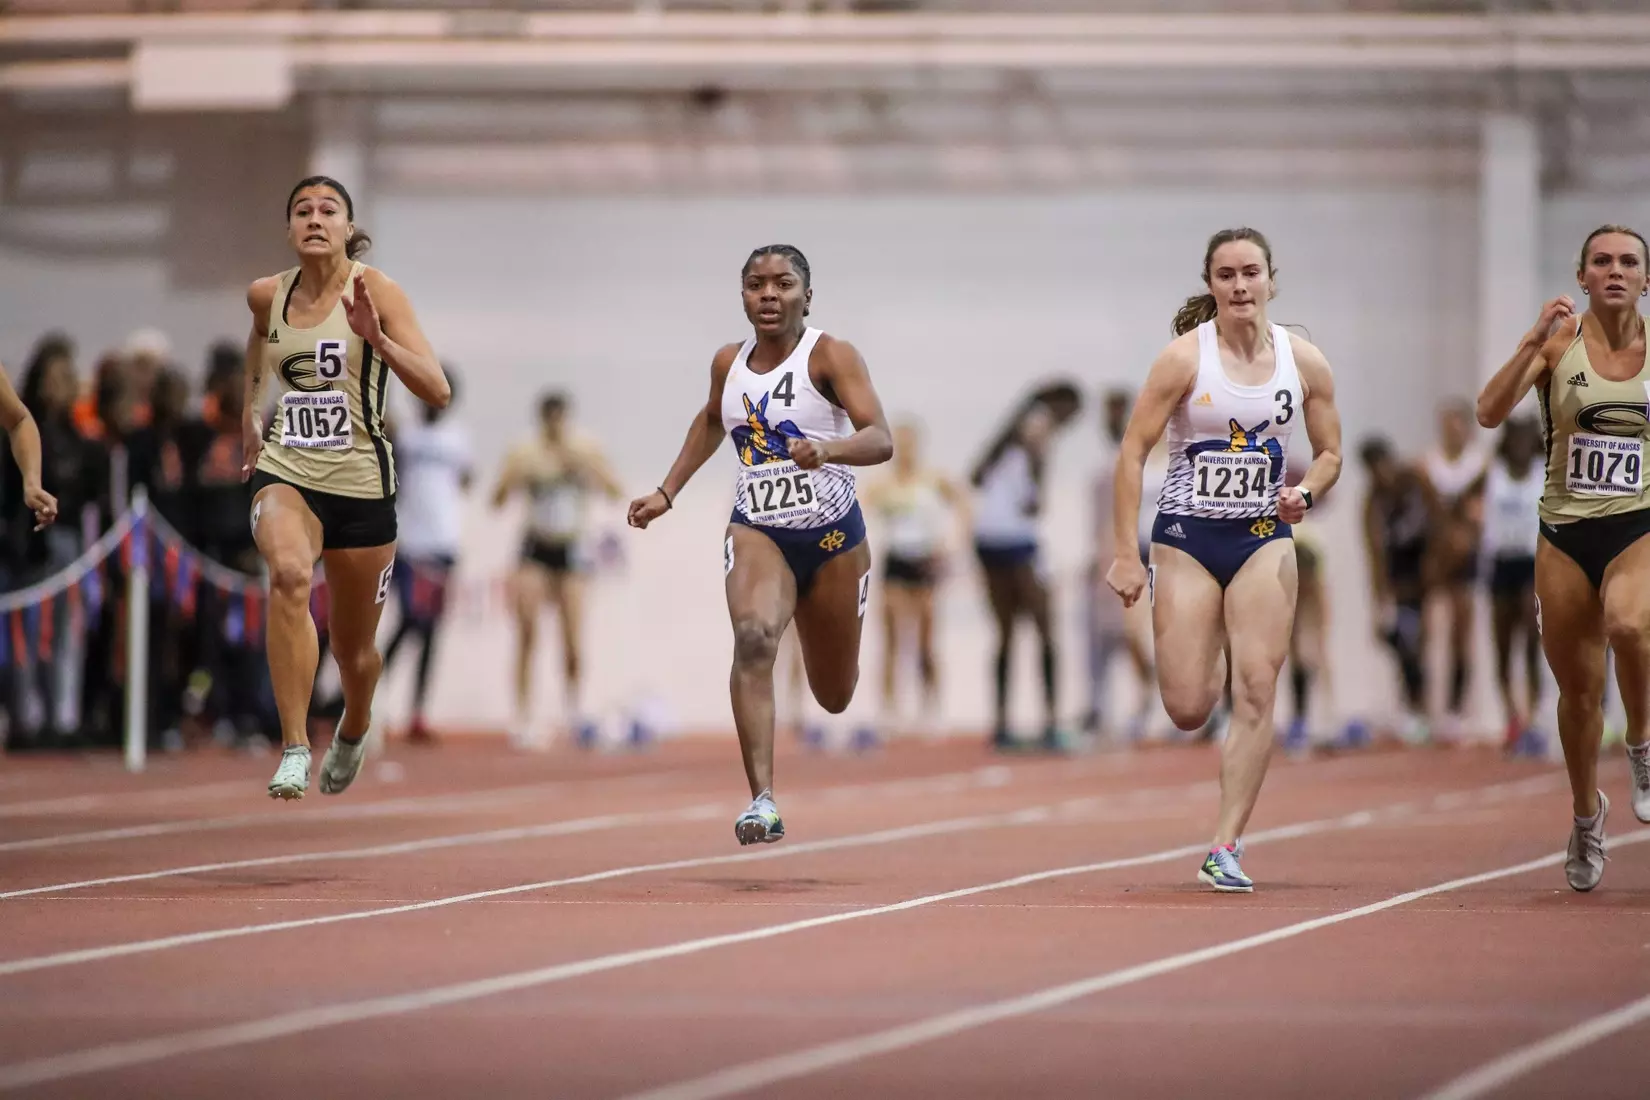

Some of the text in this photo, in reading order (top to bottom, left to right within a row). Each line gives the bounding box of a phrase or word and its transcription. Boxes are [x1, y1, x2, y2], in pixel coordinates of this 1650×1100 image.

[319, 342, 342, 378] 5
[284, 395, 344, 405] UNIVERSITY OF KANSAS
[772, 372, 795, 407] 4
[1275, 389, 1293, 425] 3
[284, 406, 349, 438] 1052
[1573, 437, 1607, 449] UNIVERSITY
[1618, 442, 1641, 452] KANSAS
[773, 467, 780, 476] OF
[781, 464, 802, 473] KANS
[1199, 455, 1267, 465] UNIVERSITY OF KANSAS
[1570, 448, 1640, 485] 1079
[747, 472, 813, 514] 1225
[1196, 466, 1266, 499] 1234
[1569, 481, 1637, 493] JAYHAWK INVITATIONAL
[1197, 500, 1264, 508] JAYHAWK INVITATIONAL
[1164, 529, 1186, 539] adidas
